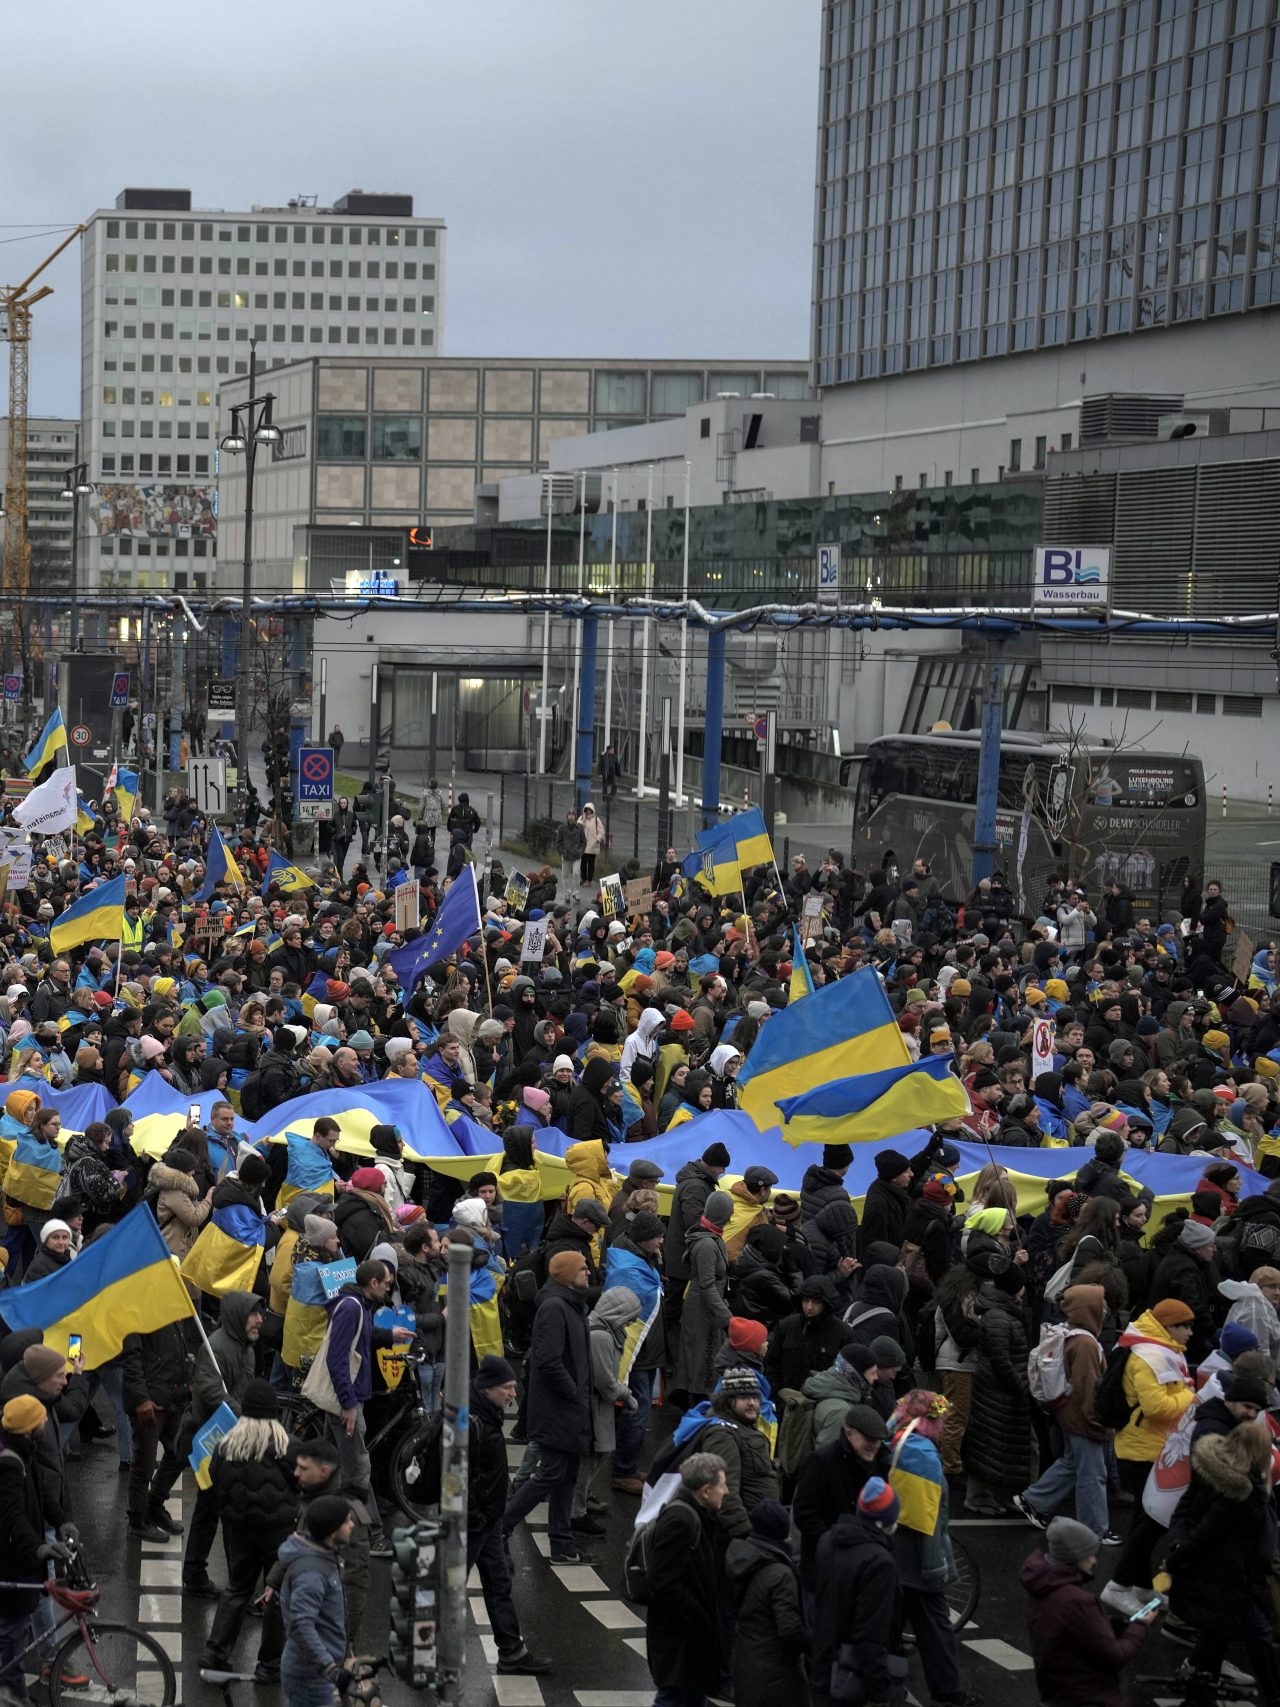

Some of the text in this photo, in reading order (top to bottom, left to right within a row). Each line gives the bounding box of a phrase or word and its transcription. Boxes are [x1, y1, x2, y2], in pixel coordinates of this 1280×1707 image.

[1043, 549, 1100, 585] BL
[1043, 589, 1099, 599] Wasserbau
[75, 731, 87, 740] 30
[303, 784, 330, 796] TAXI
[50, 845, 66, 857] OFF
